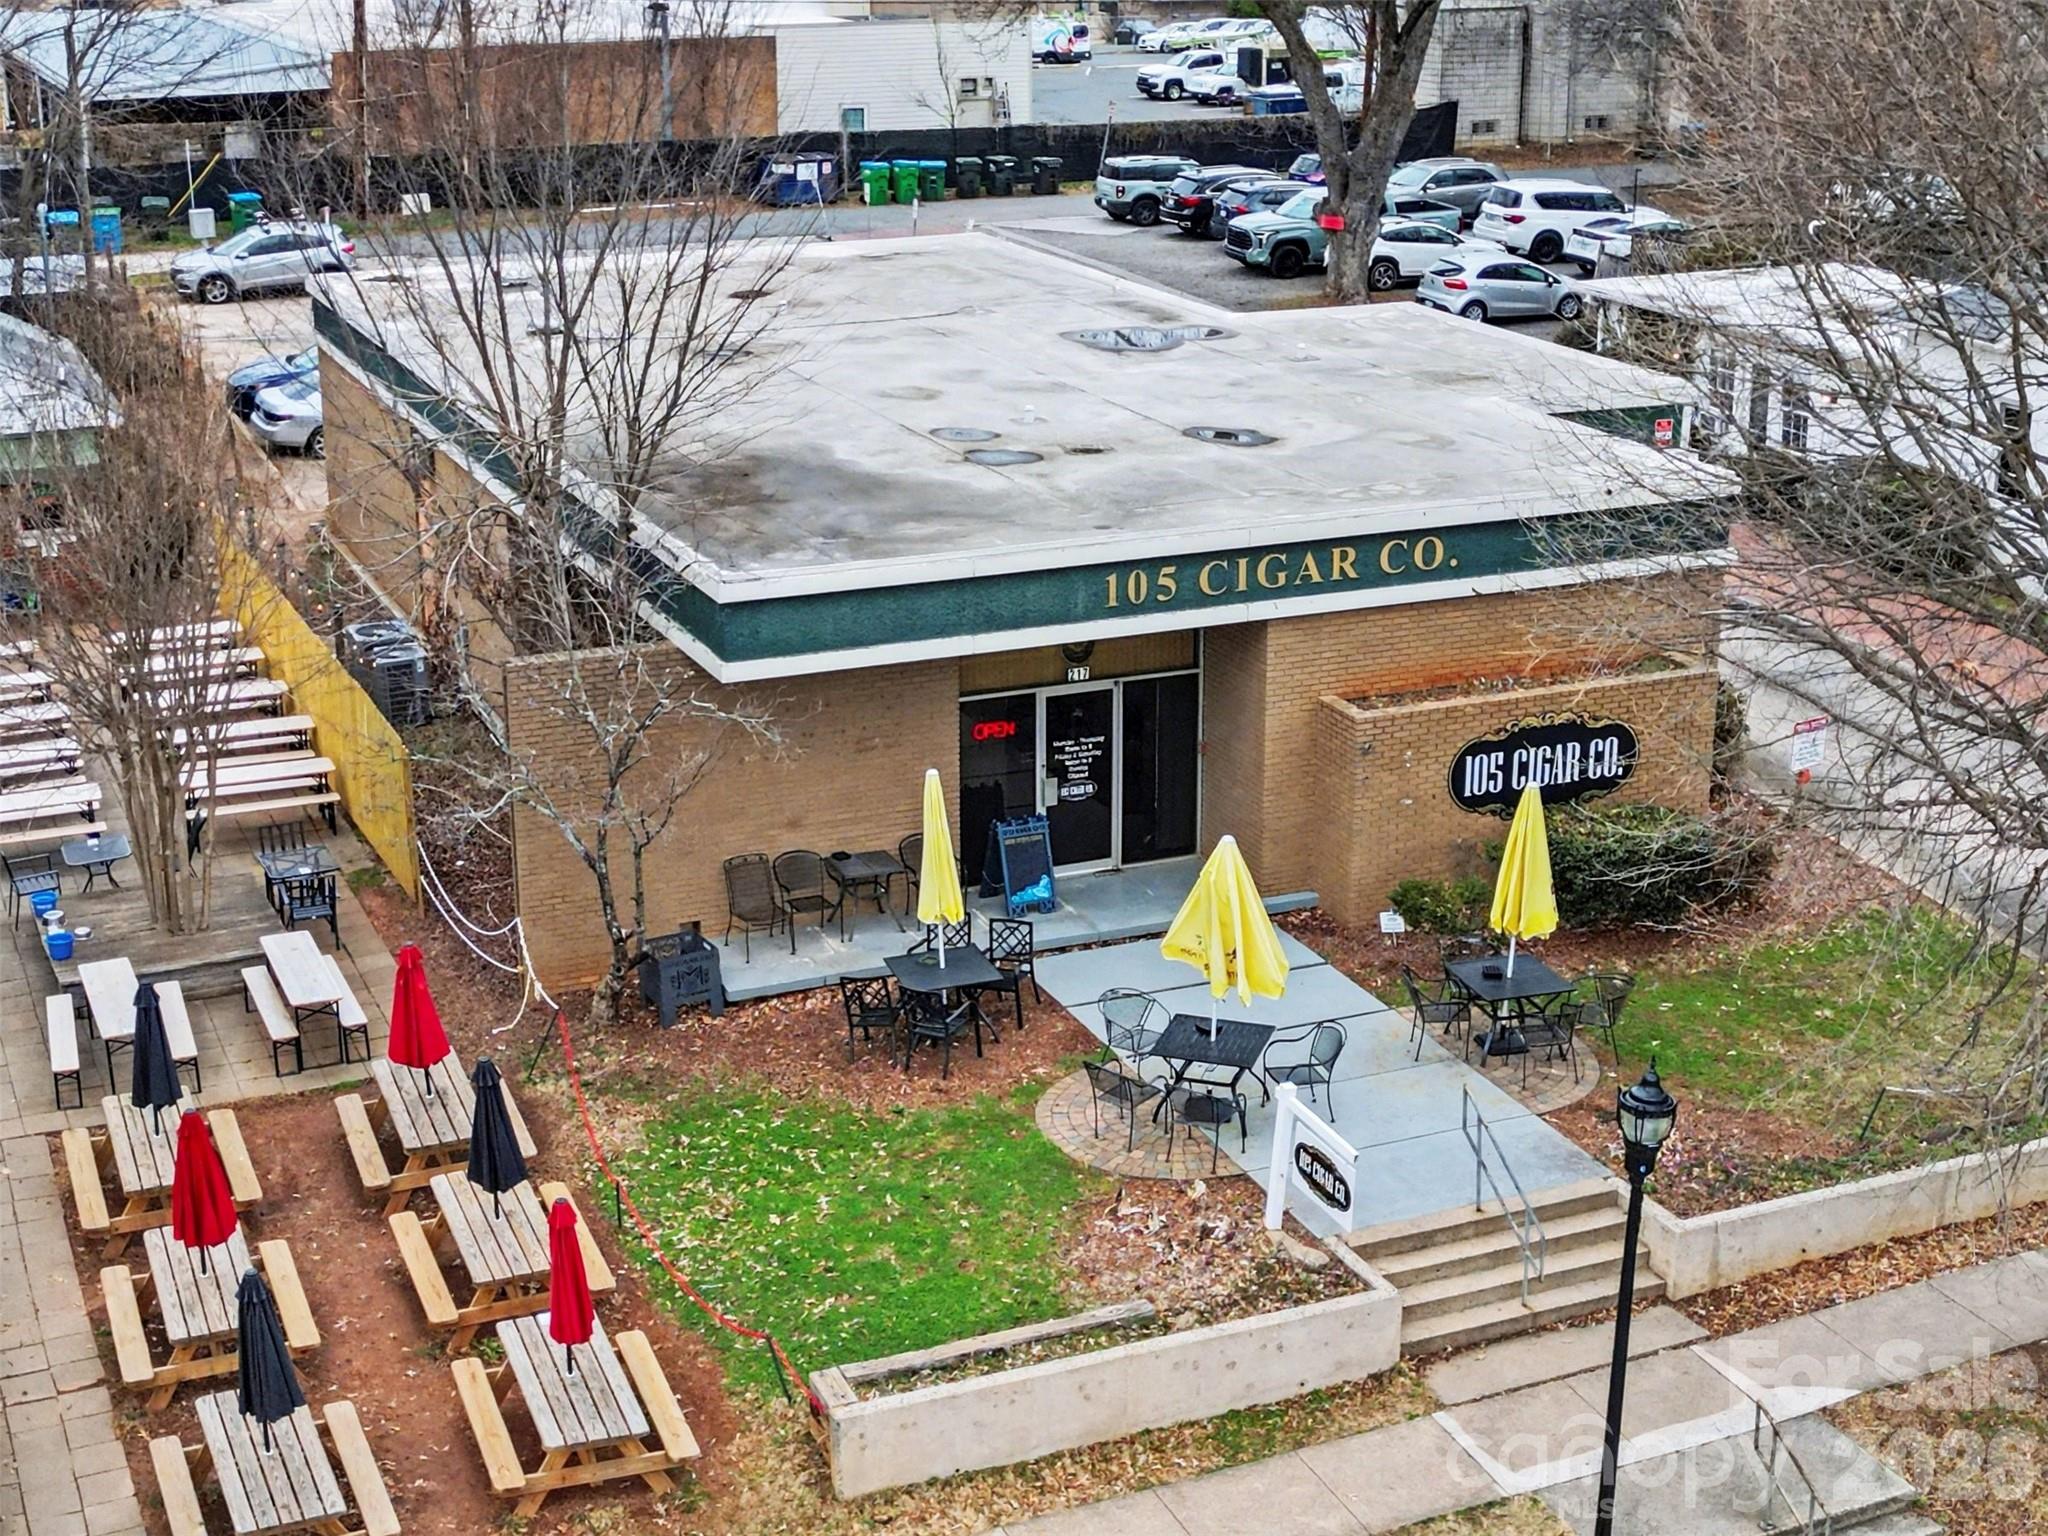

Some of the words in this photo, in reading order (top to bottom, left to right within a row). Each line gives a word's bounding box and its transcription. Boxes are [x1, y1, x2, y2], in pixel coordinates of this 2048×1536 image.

[1104, 566, 1177, 608] 105
[1199, 546, 1359, 597] CIGAR
[1379, 536, 1459, 575] CO.
[1068, 667, 1090, 682] 217
[973, 720, 1016, 741] OPEN
[1463, 751, 1504, 798] 105
[1512, 742, 1581, 792] CIGAR
[1588, 736, 1623, 780] CO.
